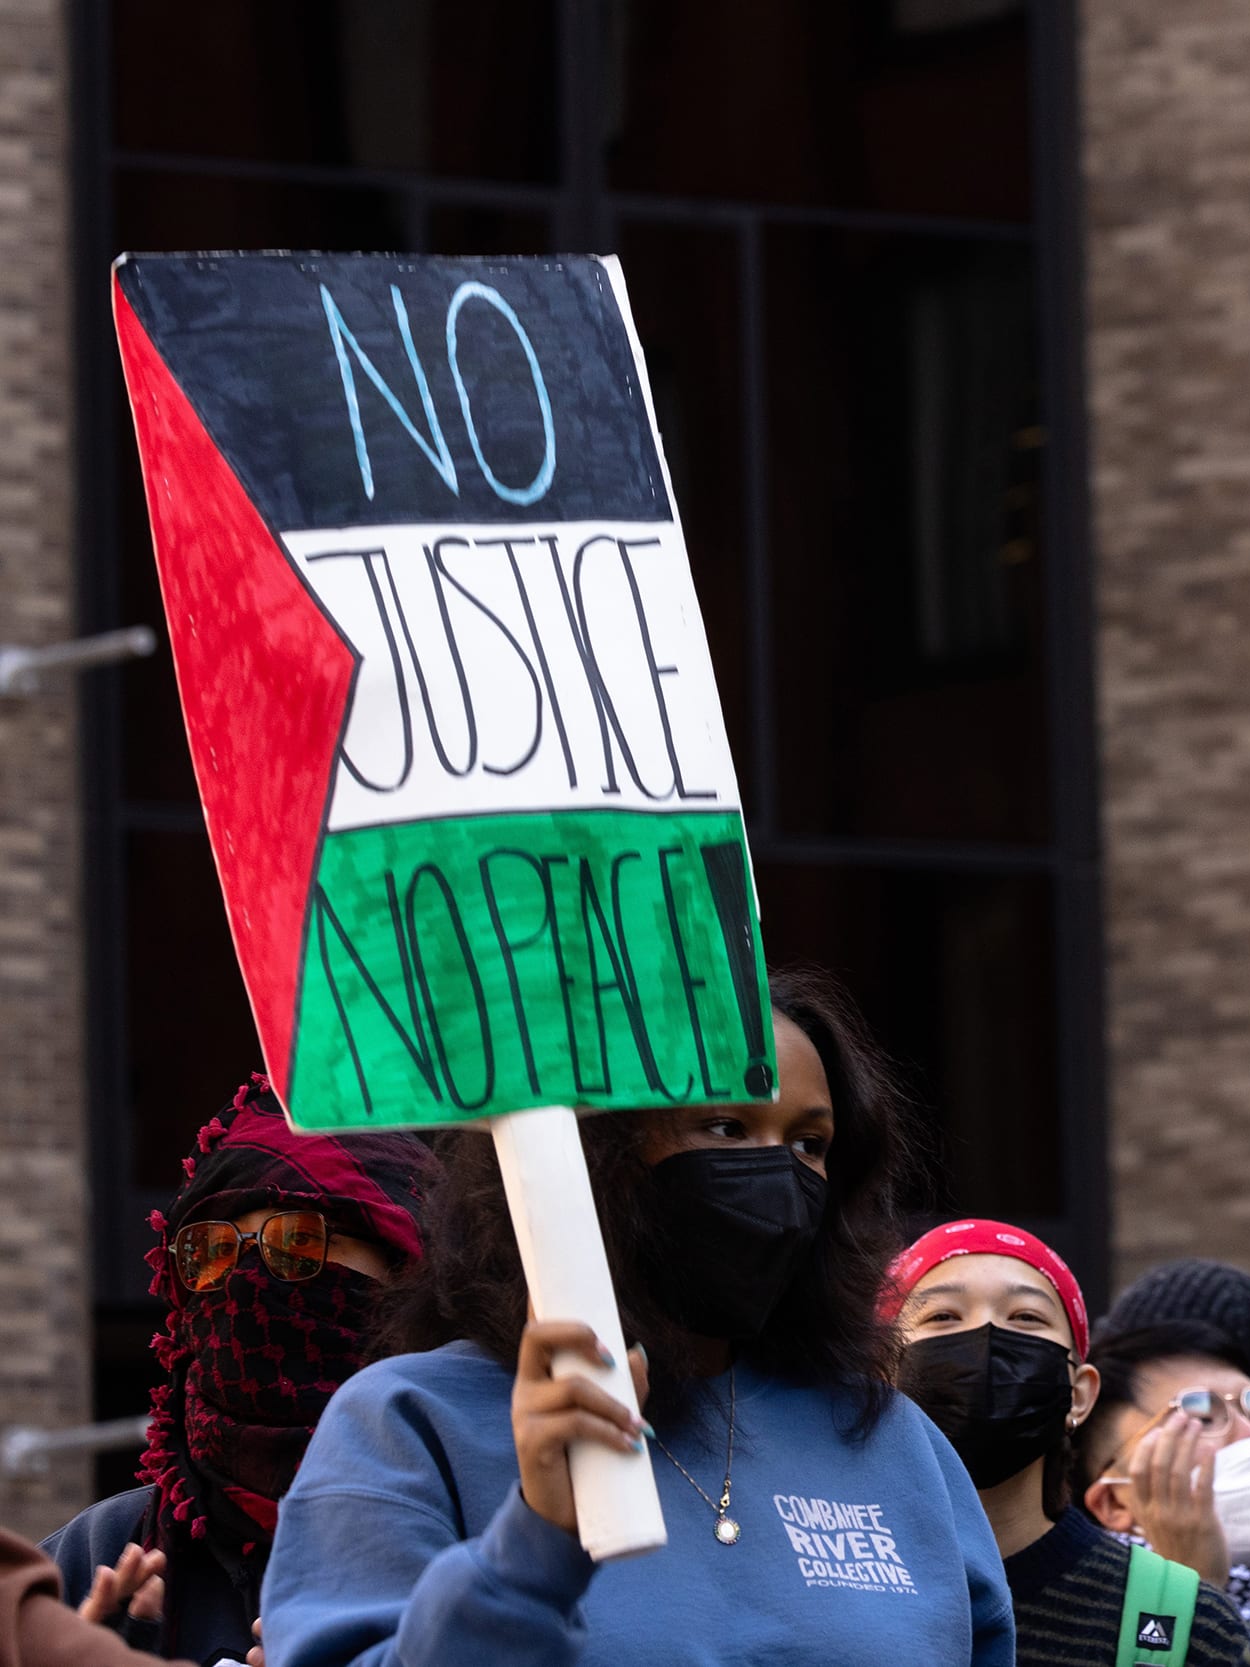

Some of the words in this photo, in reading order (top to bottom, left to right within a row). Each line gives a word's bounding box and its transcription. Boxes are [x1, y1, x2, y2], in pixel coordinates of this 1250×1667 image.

[320, 281, 556, 506] NO
[305, 534, 717, 801] JUSTICE
[315, 862, 495, 1111] NO
[478, 840, 774, 1101] PEACE!
[773, 1494, 892, 1535] COMBAHEE
[783, 1521, 905, 1565] RIVER
[797, 1557, 915, 1587] COLLECTIVE
[806, 1579, 886, 1593] FOUNDED
